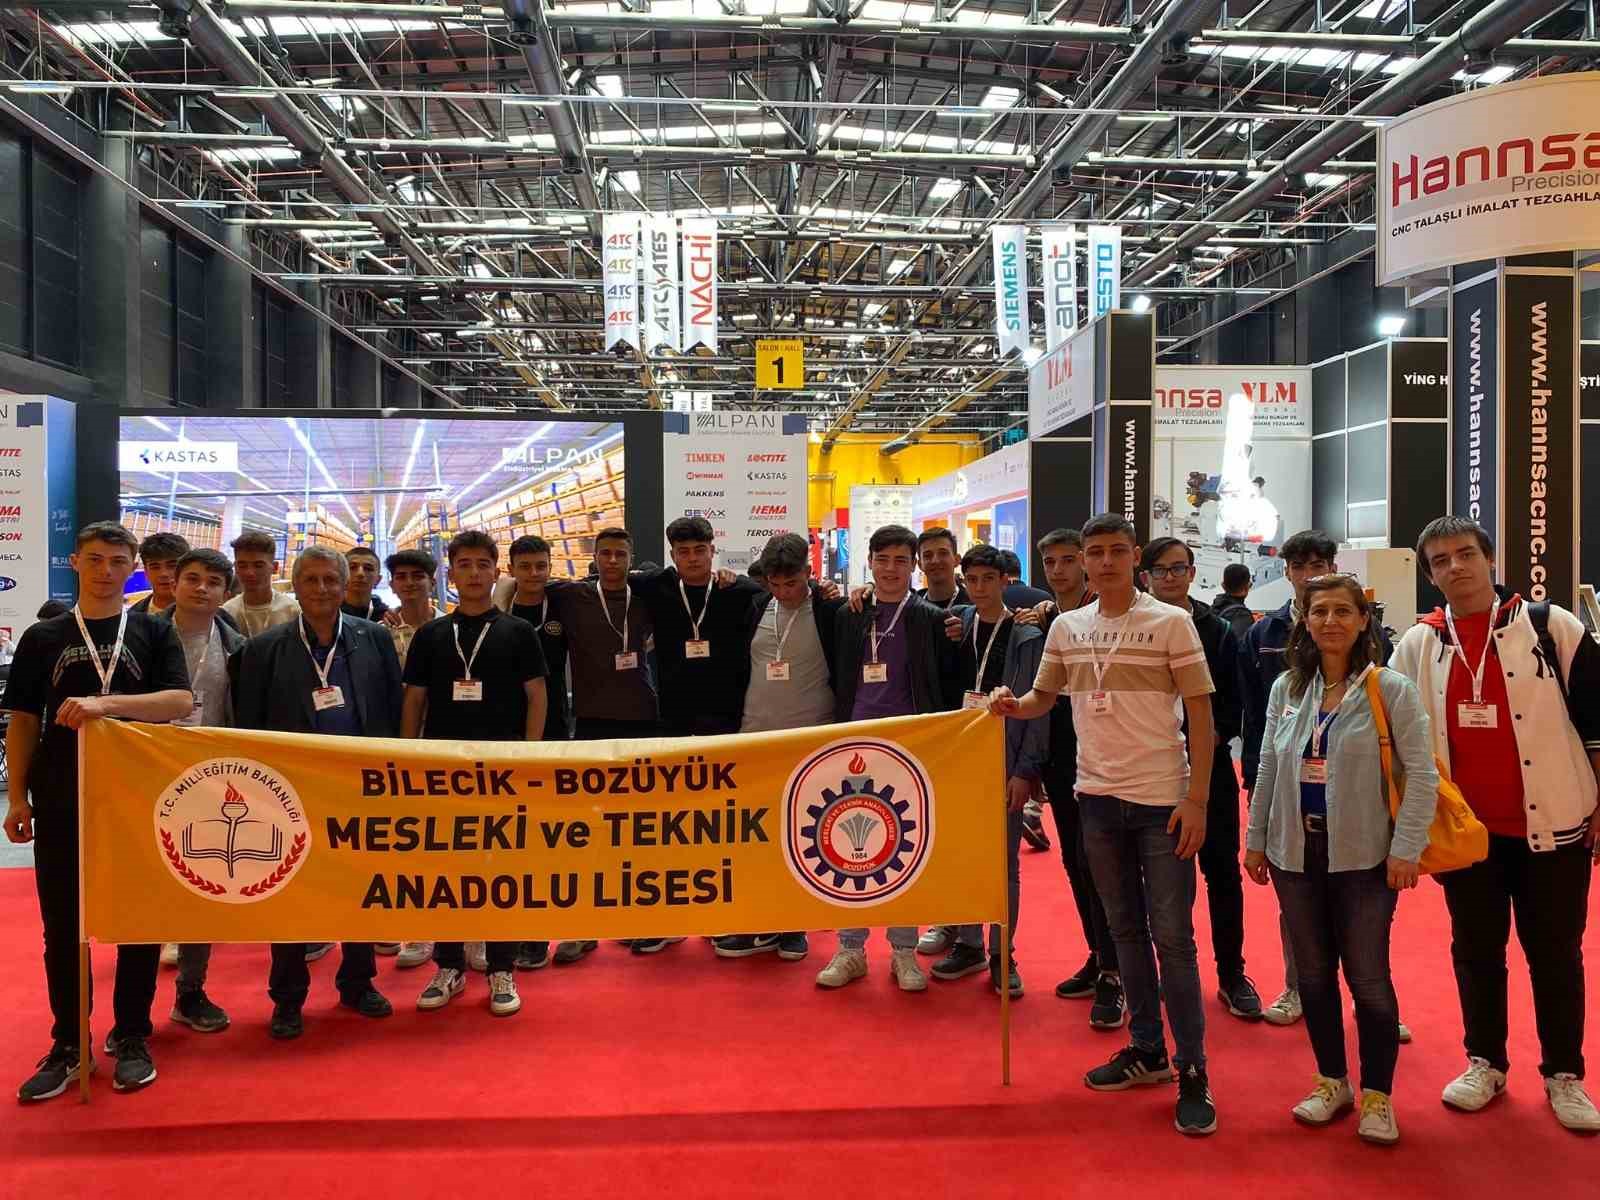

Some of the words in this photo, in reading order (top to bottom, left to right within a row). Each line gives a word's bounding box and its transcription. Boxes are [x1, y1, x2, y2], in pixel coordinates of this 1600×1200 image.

[1392, 223, 1411, 237] CNC
[1414, 209, 1462, 230] TALAŞLI
[1466, 198, 1520, 217] İMALAT
[1002, 241, 1020, 331] SIEMENS
[1097, 244, 1113, 315] ESTO
[772, 356, 784, 384] 1
[1404, 372, 1435, 385] YİNG
[1240, 382, 1297, 403] YLM
[154, 450, 218, 463] KASTAS
[687, 453, 725, 463] TIMKEN
[747, 454, 787, 462] LOCTITE
[1125, 419, 1138, 529] www.hanns
[751, 504, 787, 514] HEMA
[203, 762, 248, 777] EĞİTİM
[251, 769, 300, 823] BAKANLIĞI
[361, 762, 517, 796] BİLECİK
[555, 756, 737, 794] BOZÜYÜK
[326, 805, 527, 851] MESLEKİ
[540, 821, 590, 848] ve
[603, 799, 769, 847] TEKNİK
[361, 874, 578, 909] ANADOLU
[593, 858, 733, 907] LİSESİ
